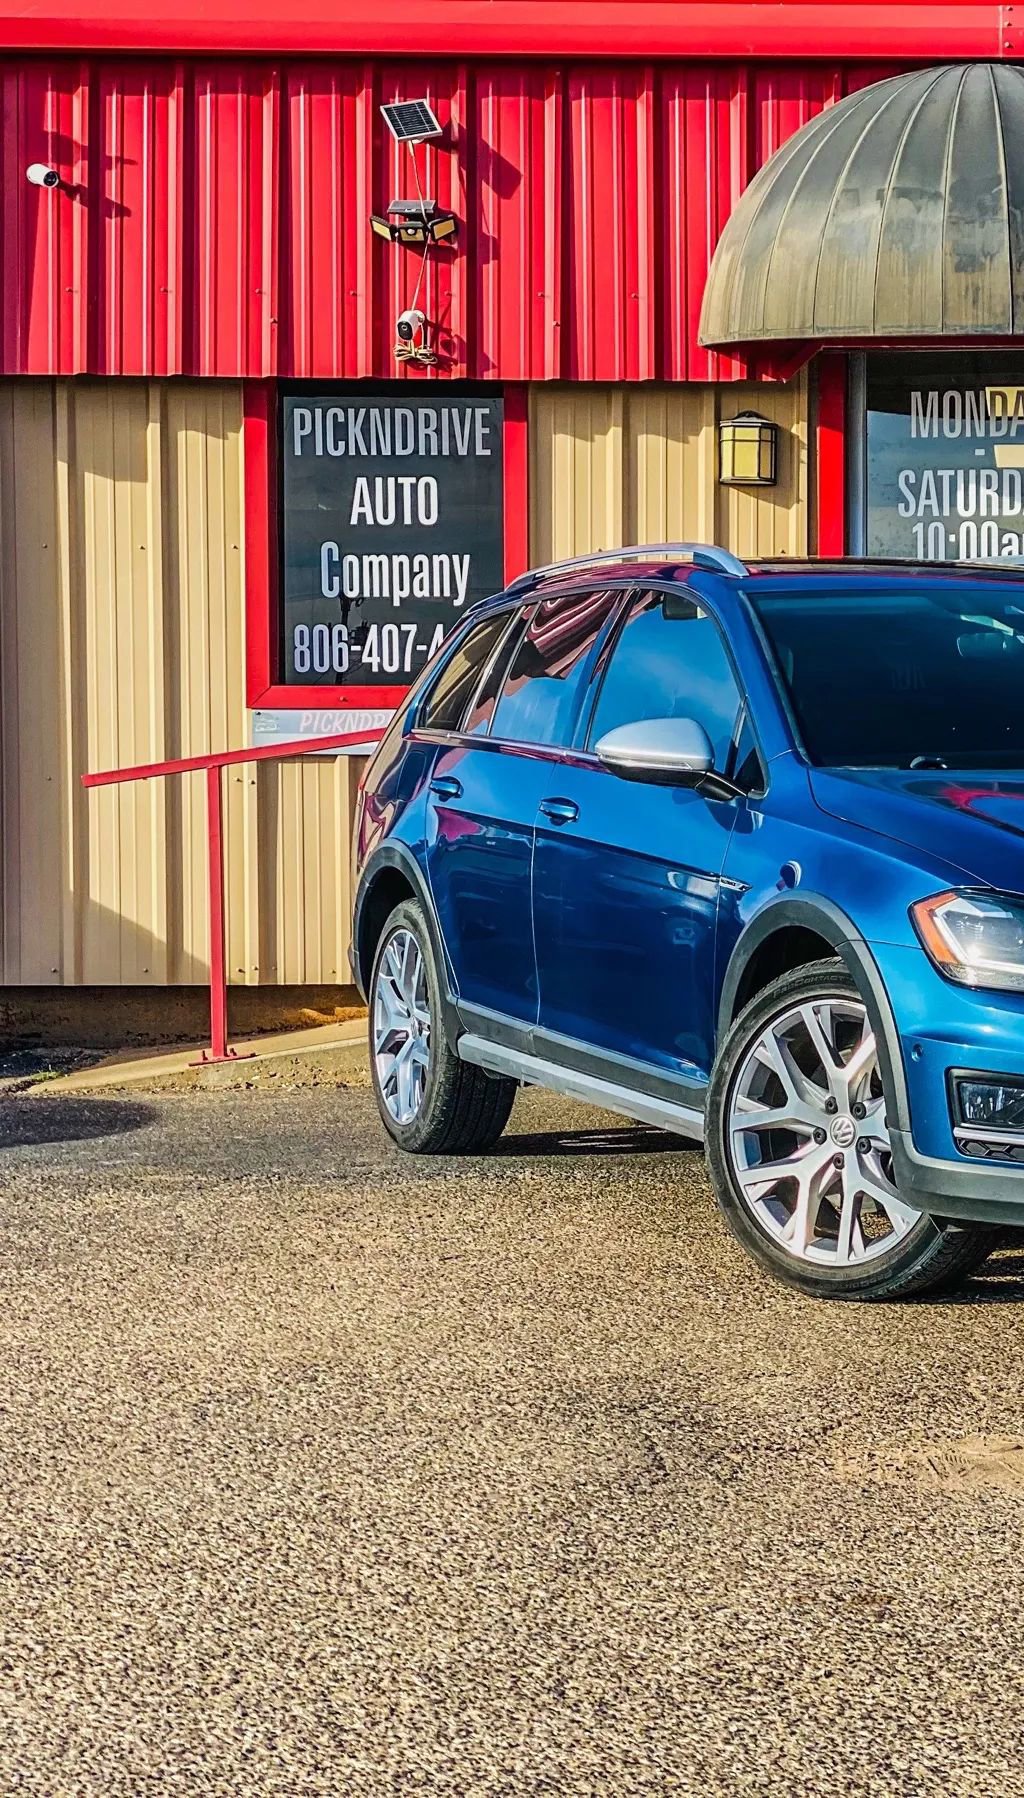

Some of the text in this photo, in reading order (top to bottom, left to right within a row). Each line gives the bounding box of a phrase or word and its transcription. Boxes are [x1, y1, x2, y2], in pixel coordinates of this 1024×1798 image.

[293, 407, 491, 456] PICKNDRIVE
[350, 476, 438, 525] AUTO
[320, 541, 470, 606] Company
